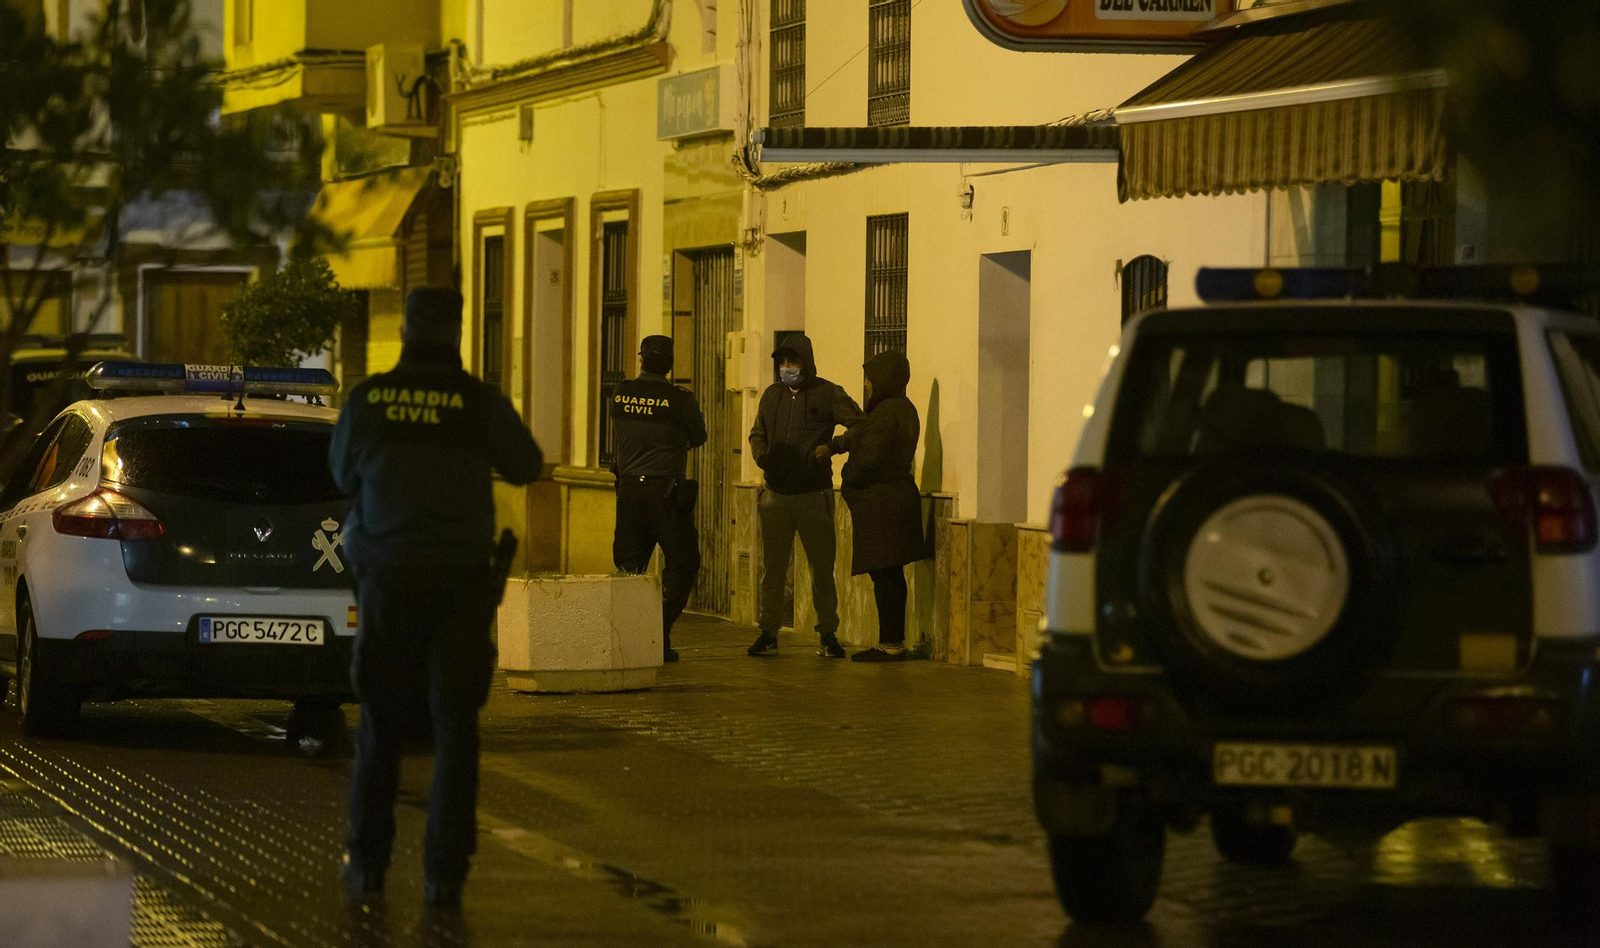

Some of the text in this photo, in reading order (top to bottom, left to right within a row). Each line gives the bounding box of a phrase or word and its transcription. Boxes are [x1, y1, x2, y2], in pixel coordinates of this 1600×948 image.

[1100, 0, 1211, 12] DEL CARMEN
[188, 365, 240, 373] GUARDIA
[199, 372, 230, 380] CIVIL
[367, 388, 464, 409] GUARDIA
[615, 395, 670, 407] GUARDIA
[385, 404, 440, 424] CIVIL
[624, 405, 653, 415] CIVIL
[213, 621, 249, 640] PGC
[253, 621, 302, 641] 5472
[305, 623, 318, 642] C
[1217, 750, 1391, 782] PGC 2018 N
